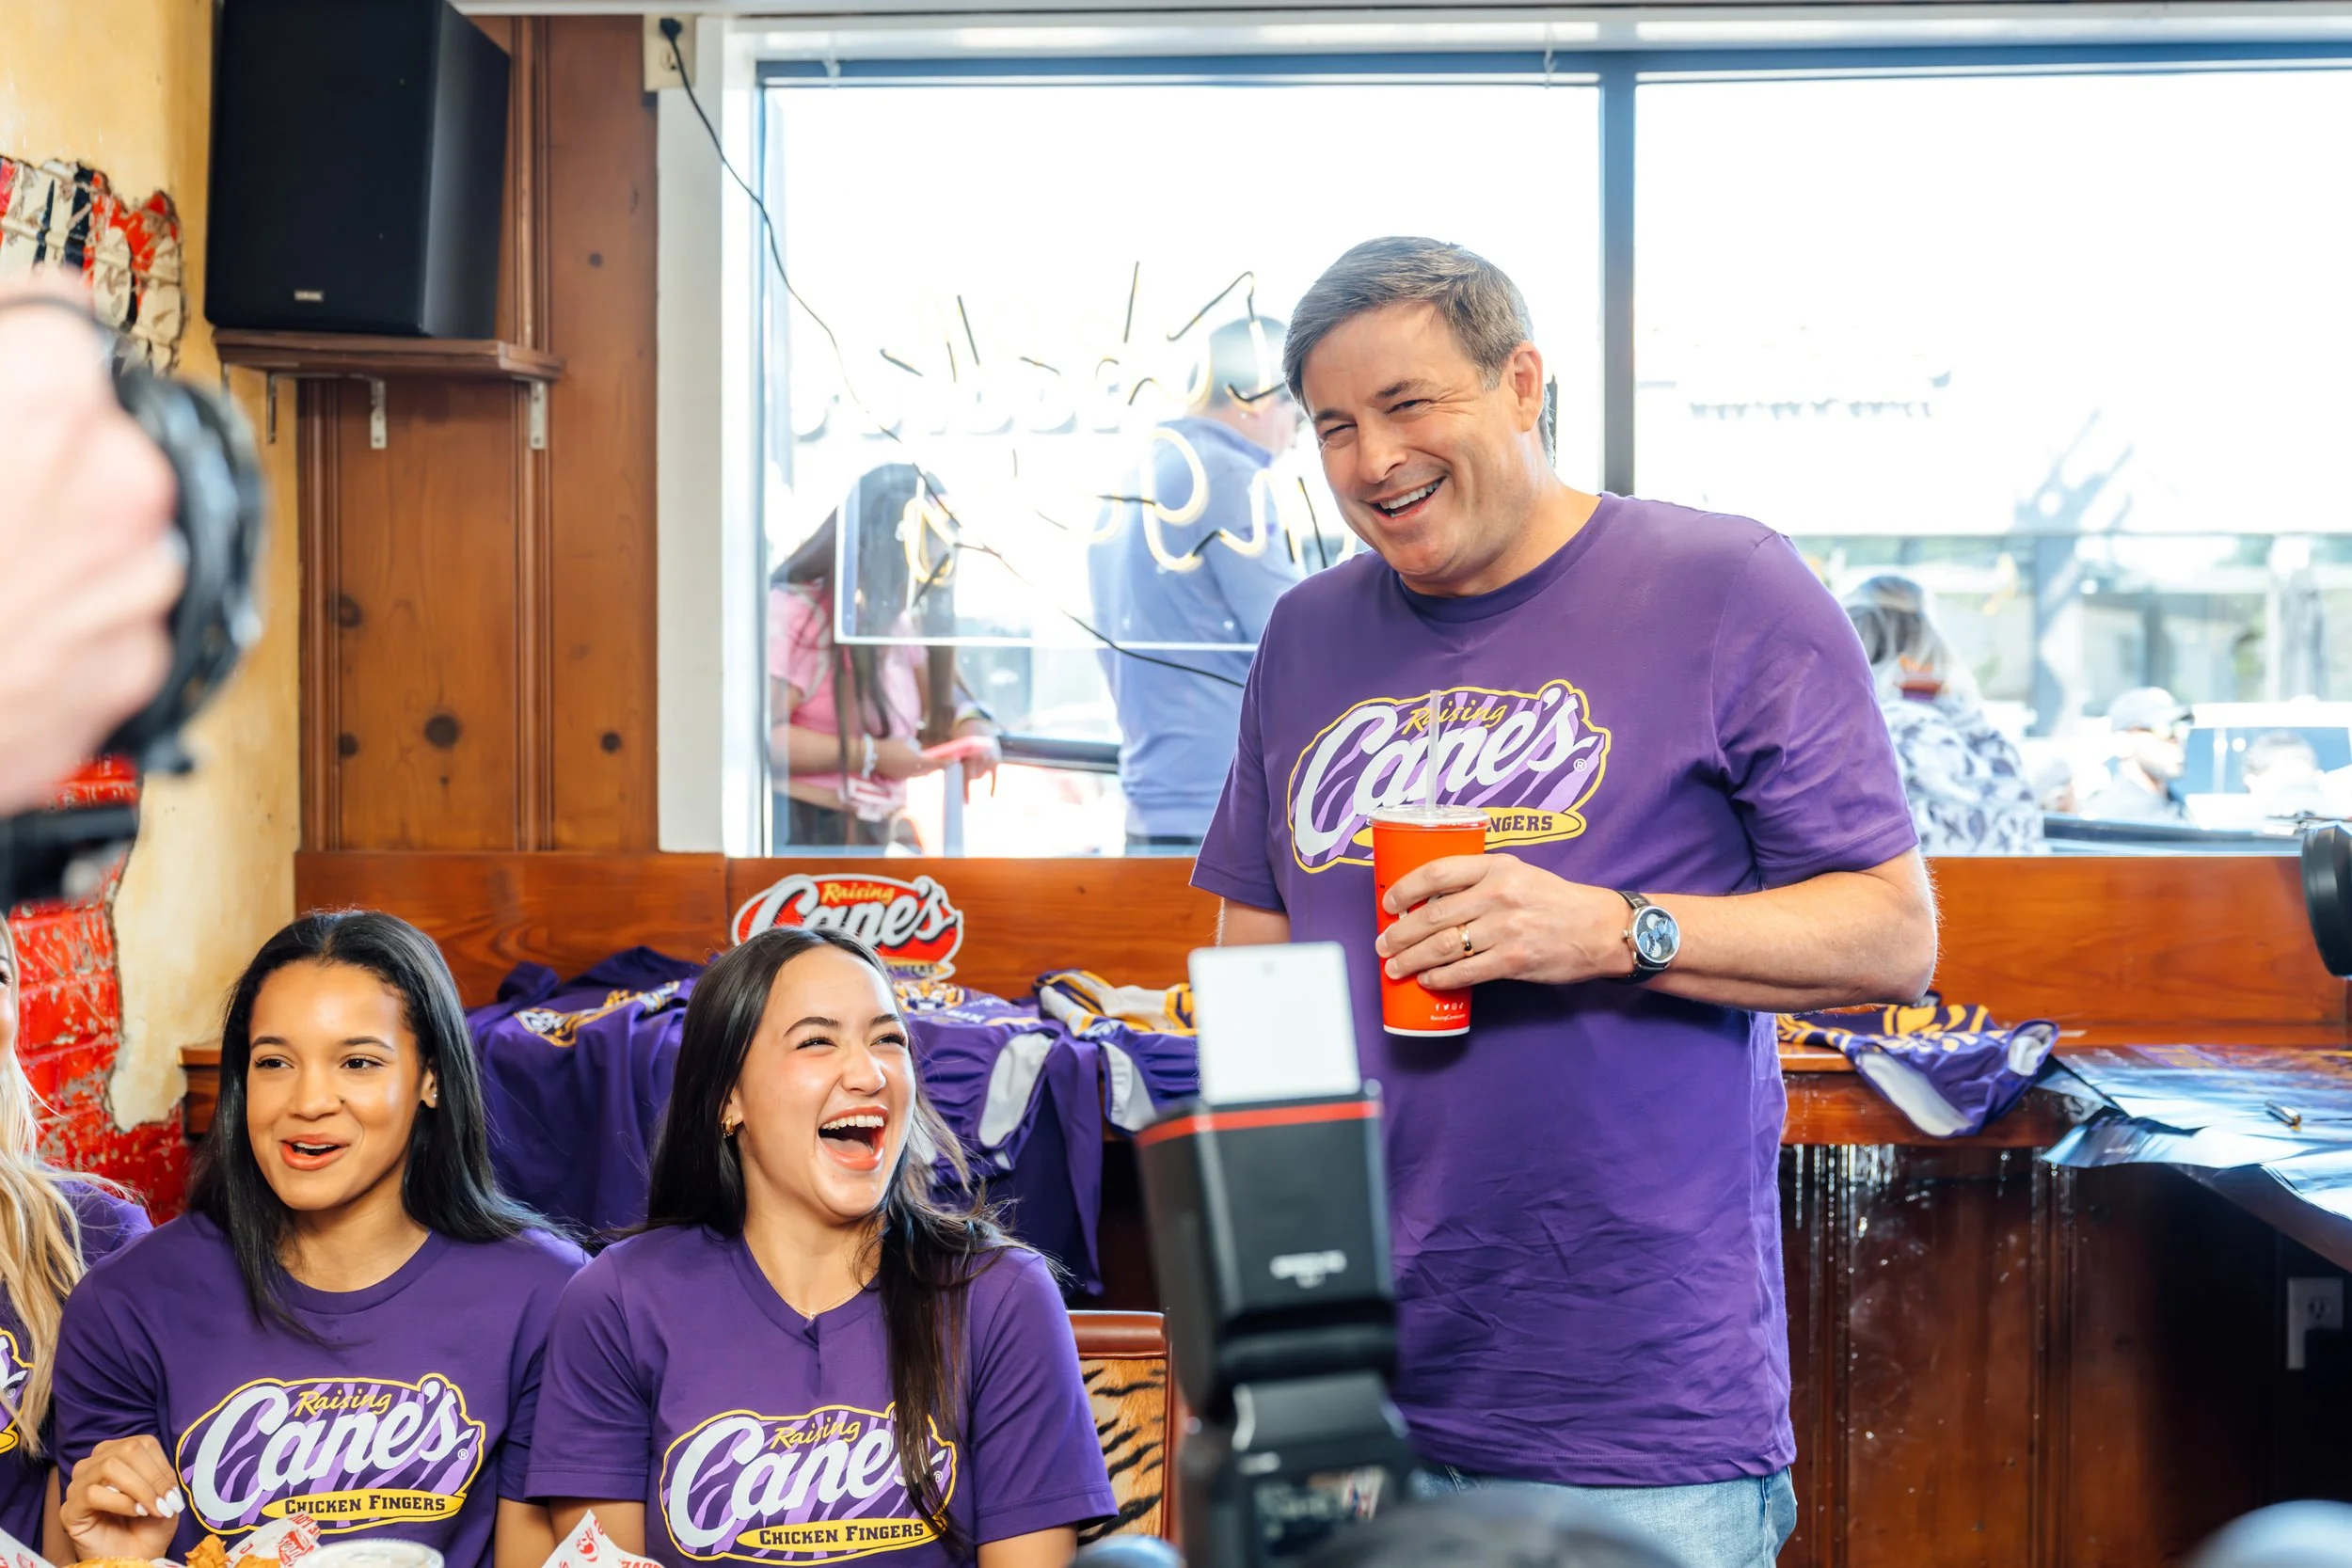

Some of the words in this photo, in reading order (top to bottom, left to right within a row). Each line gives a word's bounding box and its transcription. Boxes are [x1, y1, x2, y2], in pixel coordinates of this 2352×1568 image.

[1401, 700, 1507, 735] Raising
[1295, 687, 1598, 856] Cane's
[1486, 815, 1553, 832] NGERS
[820, 882, 896, 904] Raising
[296, 1388, 392, 1417] Raising
[770, 1417, 862, 1449] Raising
[192, 1380, 476, 1521] Cane's
[370, 1495, 446, 1512] FINGERS
[759, 1528, 839, 1545] CHICKEN
[846, 1523, 924, 1542] FINGERS
